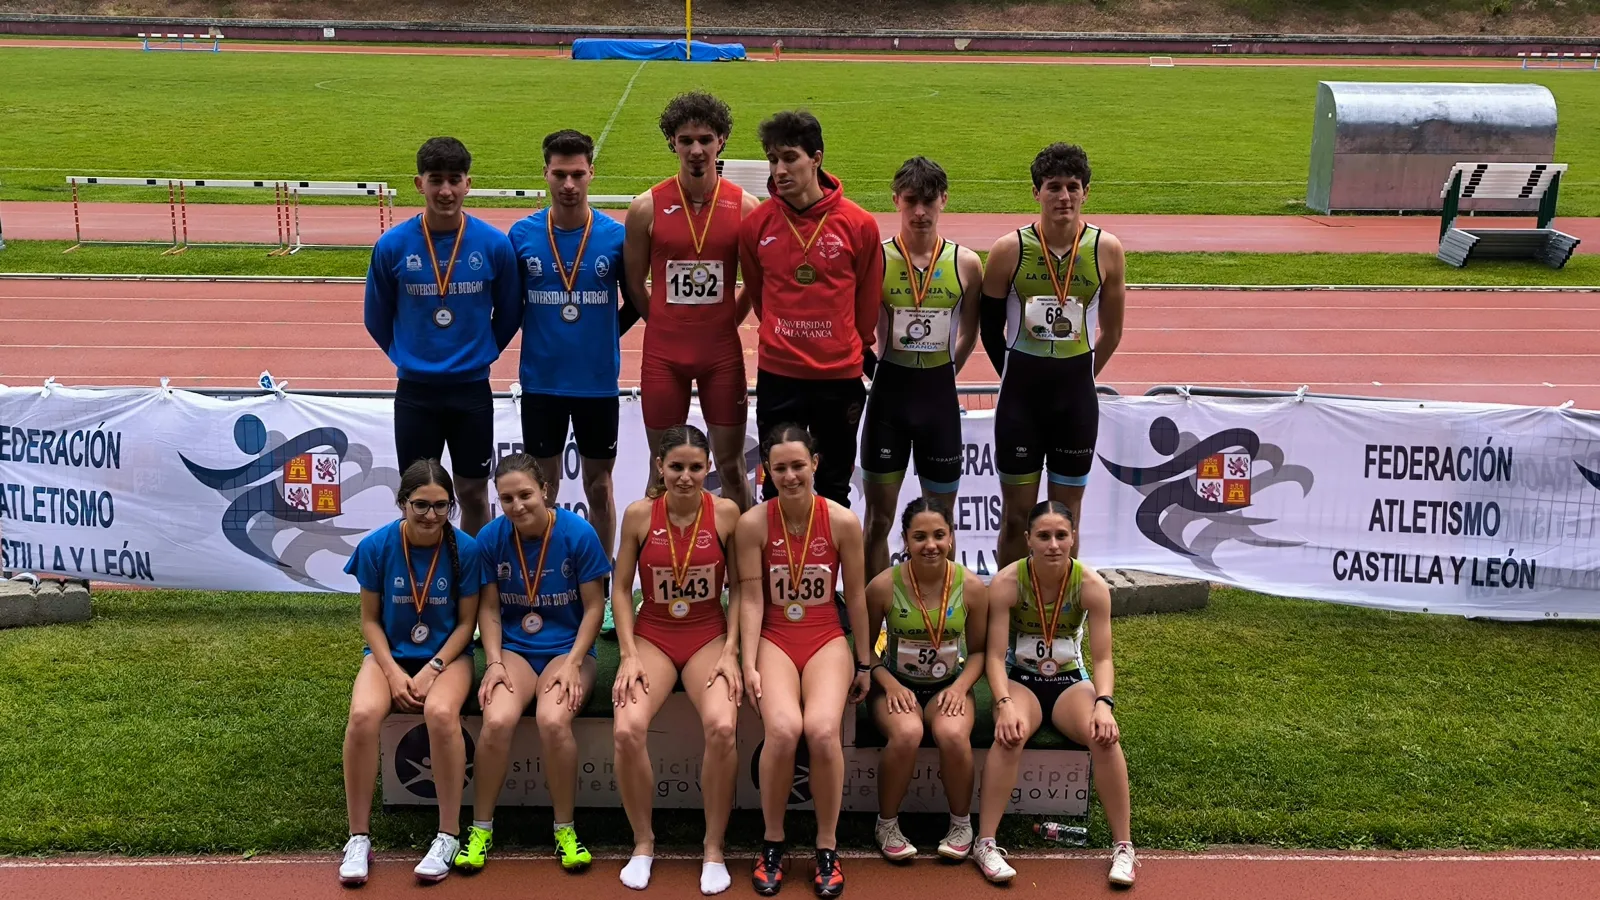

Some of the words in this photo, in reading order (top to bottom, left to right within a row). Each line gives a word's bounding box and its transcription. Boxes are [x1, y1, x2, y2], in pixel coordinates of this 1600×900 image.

[459, 281, 483, 295] BURGOS
[583, 290, 608, 305] BURGOS
[1364, 437, 1513, 482] FEDERACIÓN
[1368, 498, 1500, 537] ATLETISMO
[69, 546, 85, 572] Y
[1333, 550, 1444, 585] CASTILLA
[1450, 556, 1466, 585] Y
[1471, 549, 1536, 589] LEÓN
[659, 578, 709, 600] 1543
[775, 578, 825, 601] 1538
[918, 649, 937, 665] 52
[1009, 784, 1087, 804] govia
